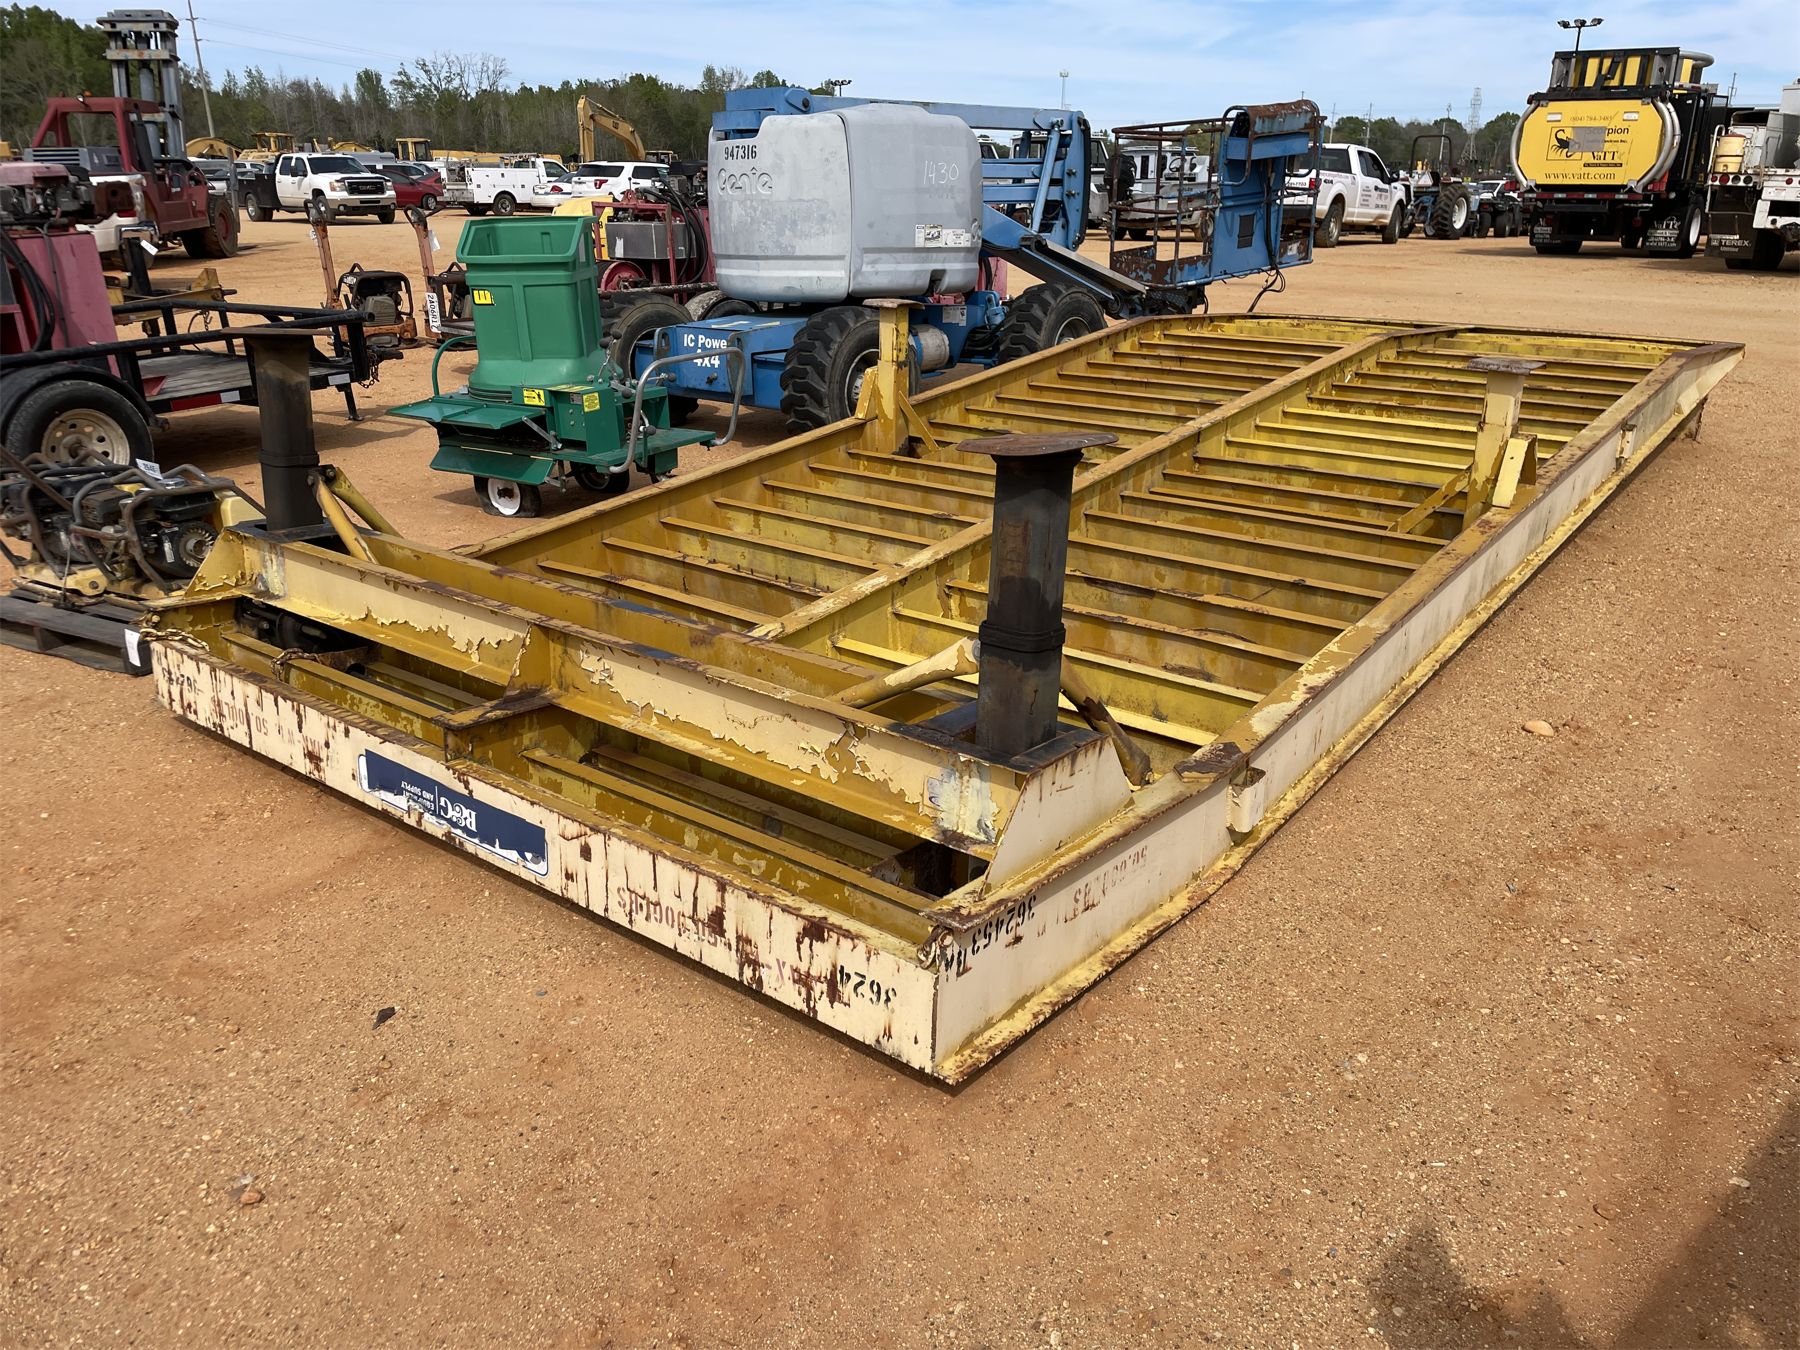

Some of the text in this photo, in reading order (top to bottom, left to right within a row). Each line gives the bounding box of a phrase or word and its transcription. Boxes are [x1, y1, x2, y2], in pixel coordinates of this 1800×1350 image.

[724, 144, 758, 161] 947316
[717, 167, 775, 195] Genie
[922, 160, 960, 185] 1430
[1544, 172, 1616, 181] www.vatt.com
[1721, 239, 1750, 247] TEREX
[683, 333, 695, 347] IC
[400, 780, 435, 802] AND SUPPLY
[438, 795, 478, 833] B&G
[972, 894, 1038, 956] 362453
[838, 964, 897, 1009] 3624
